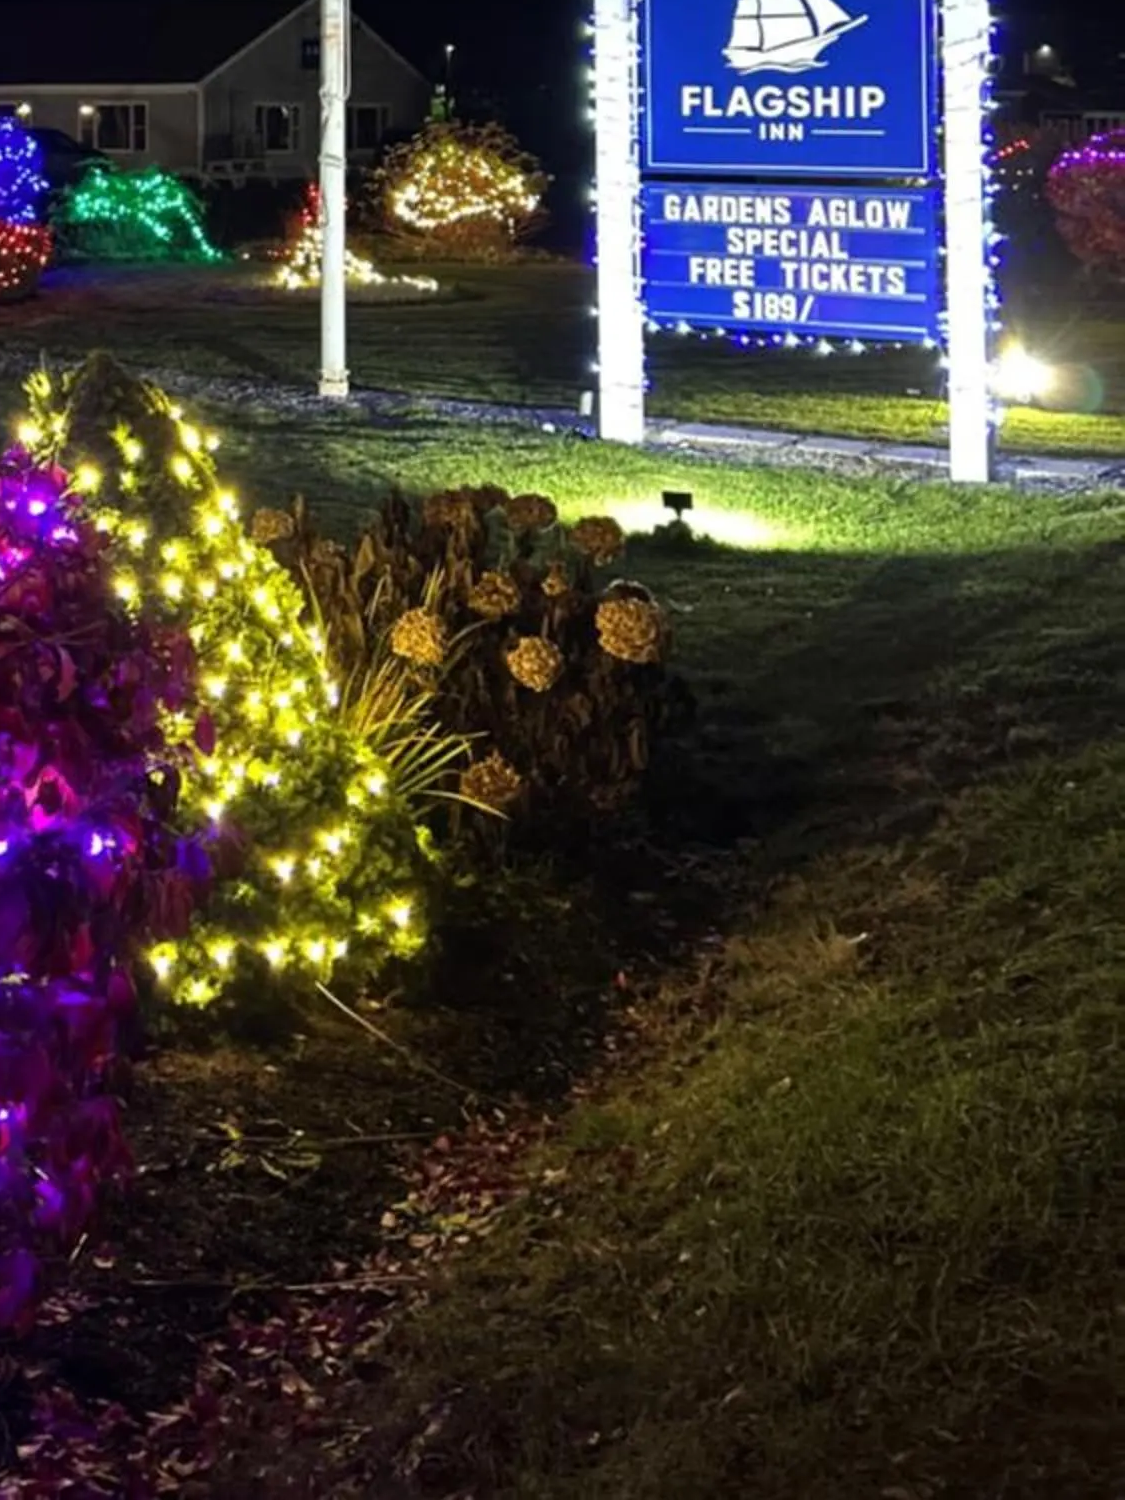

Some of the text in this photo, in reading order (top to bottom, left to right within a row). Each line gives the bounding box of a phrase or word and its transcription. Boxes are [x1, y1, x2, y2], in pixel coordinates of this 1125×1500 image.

[681, 85, 886, 118] FLAGSHIP
[759, 122, 804, 141] INN
[663, 194, 911, 229] GARDENS AGLOW
[727, 226, 849, 260] SPECIAL
[688, 257, 907, 295] FREE TICKETS
